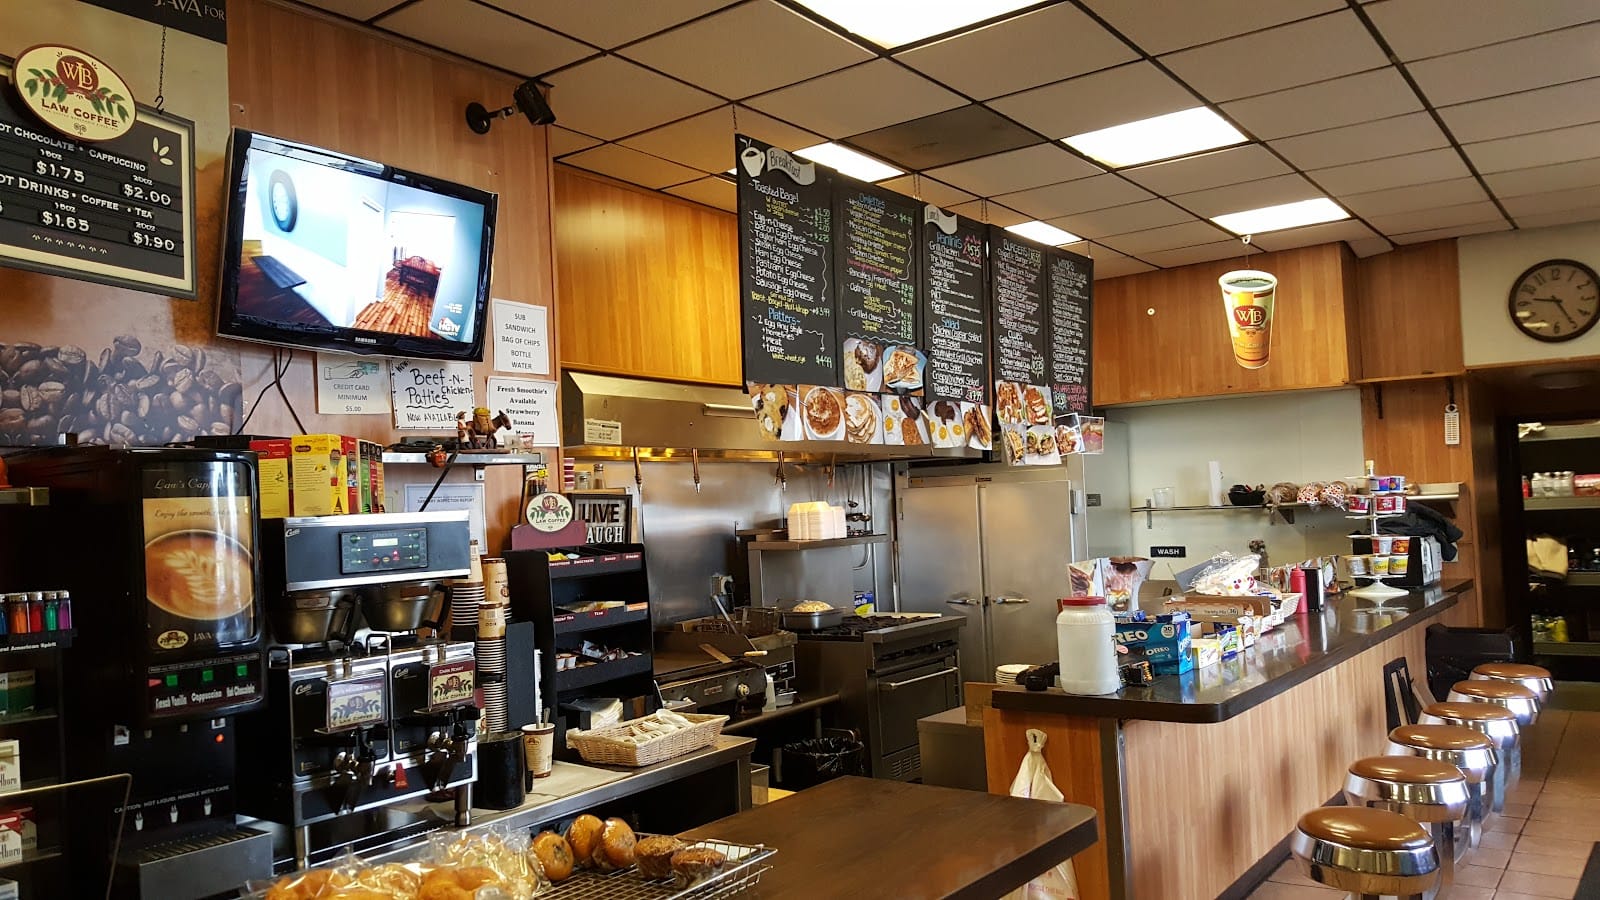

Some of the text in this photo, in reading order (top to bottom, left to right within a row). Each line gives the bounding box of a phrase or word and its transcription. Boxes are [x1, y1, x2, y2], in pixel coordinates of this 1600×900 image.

[204, 5, 225, 20] FOR
[41, 98, 119, 128] LAW COFFEE
[14, 127, 147, 172] CHOCOLATE CAPPUCCINO
[36, 160, 85, 183] $1.75
[18, 177, 70, 200] DRINKS
[81, 194, 119, 211] COFFEE
[135, 207, 153, 220] TEA
[123, 183, 171, 206] $2.00
[779, 186, 798, 207] Bagel
[42, 210, 90, 232] $1.65
[754, 220, 774, 234] Bacon
[775, 227, 787, 240] Egg
[133, 231, 175, 251] $1.90
[787, 240, 798, 252] Egg
[769, 250, 780, 264] Egg
[772, 243, 784, 257] Egg
[777, 273, 788, 285] Egg
[785, 265, 796, 279] Egg
[782, 285, 794, 298] Egg
[514, 313, 526, 321] SUB
[757, 314, 762, 325] 2
[763, 317, 775, 329] Egg
[505, 323, 536, 334] SANDWICH
[501, 335, 514, 344] BAG
[523, 338, 540, 347] CHIPS
[511, 349, 531, 359] BOTTLE
[511, 361, 532, 370] WATER
[409, 368, 446, 386] Beef
[333, 383, 353, 391] CREDIT
[497, 385, 515, 393] Fresh
[405, 386, 471, 405] Patties Chicken
[509, 397, 537, 405] Available
[506, 408, 540, 416] Strawberry
[579, 503, 620, 523] LIVE
[586, 526, 624, 543] AUGH
[1146, 646, 1170, 655] OREO
[191, 689, 222, 703] Cappuccino
